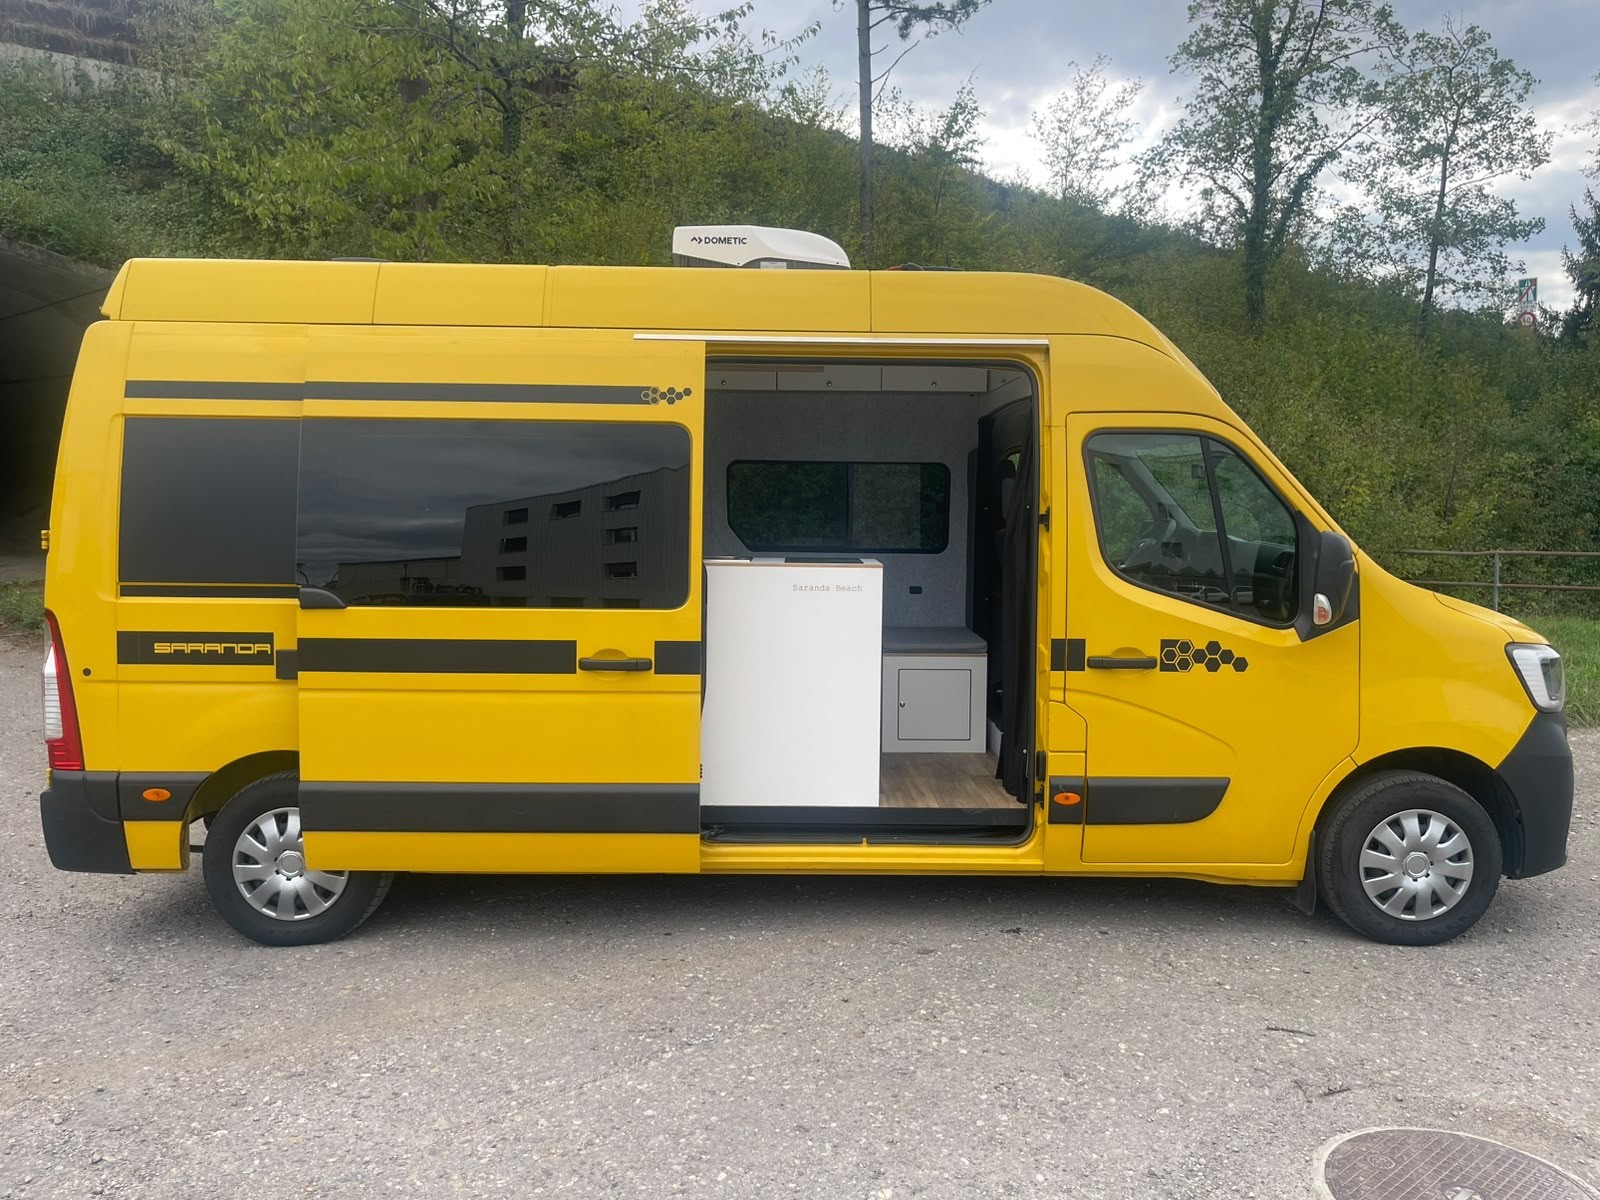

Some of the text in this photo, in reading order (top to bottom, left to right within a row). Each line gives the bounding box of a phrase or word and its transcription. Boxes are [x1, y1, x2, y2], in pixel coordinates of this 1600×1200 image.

[704, 236, 747, 245] DOMETIC
[792, 584, 863, 592] Saranda Beach
[154, 642, 271, 655] SARANDA
